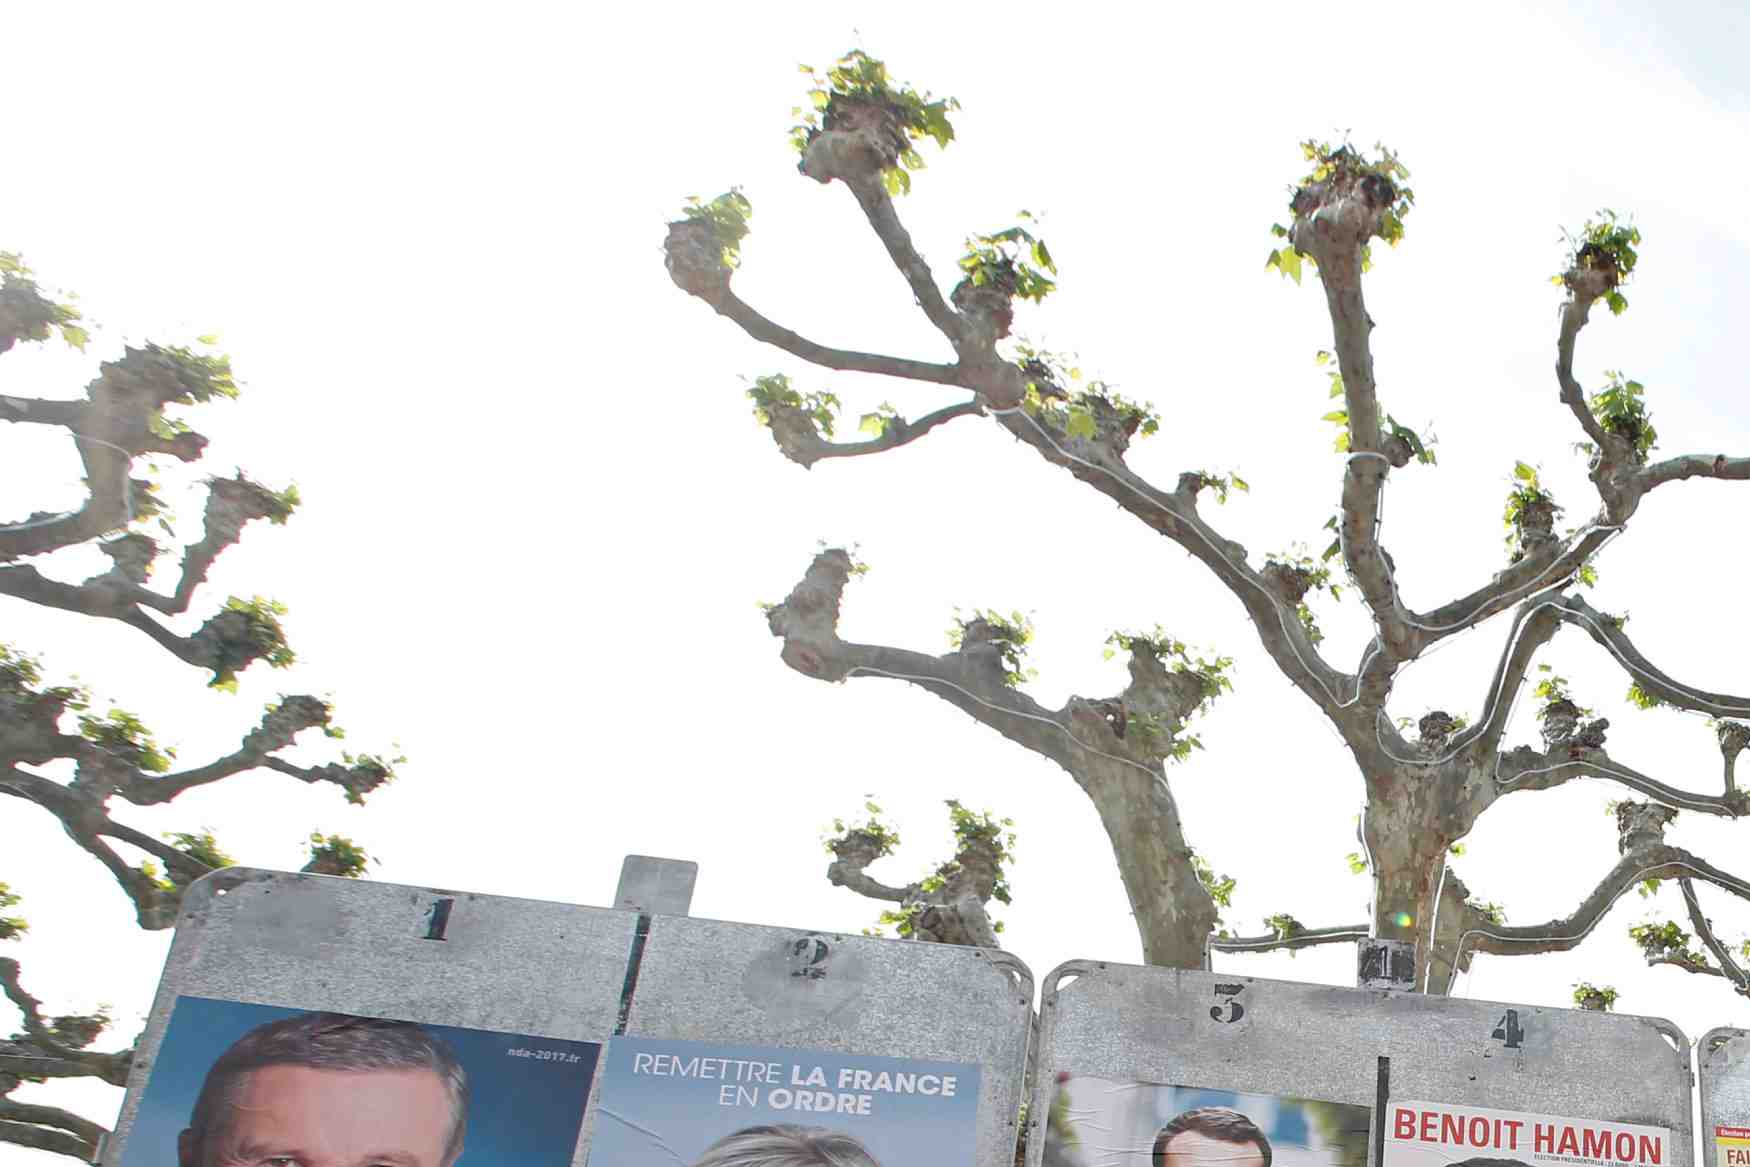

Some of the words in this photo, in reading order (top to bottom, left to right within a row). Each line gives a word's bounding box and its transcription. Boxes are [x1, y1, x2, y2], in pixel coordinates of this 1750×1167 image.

[423, 897, 454, 941] 1
[791, 936, 829, 979] 2
[1209, 984, 1244, 1024] 3
[1491, 1008, 1526, 1049] 4
[507, 1048, 581, 1064] nda-2017.fr
[633, 1053, 781, 1085] REMETTRE
[791, 1065, 826, 1088] LA
[838, 1068, 956, 1097] FRANCE
[720, 1084, 758, 1107] EN
[768, 1087, 872, 1116] ORDRE
[1394, 1108, 1524, 1151] BENOIT
[1534, 1123, 1661, 1165] HAMON
